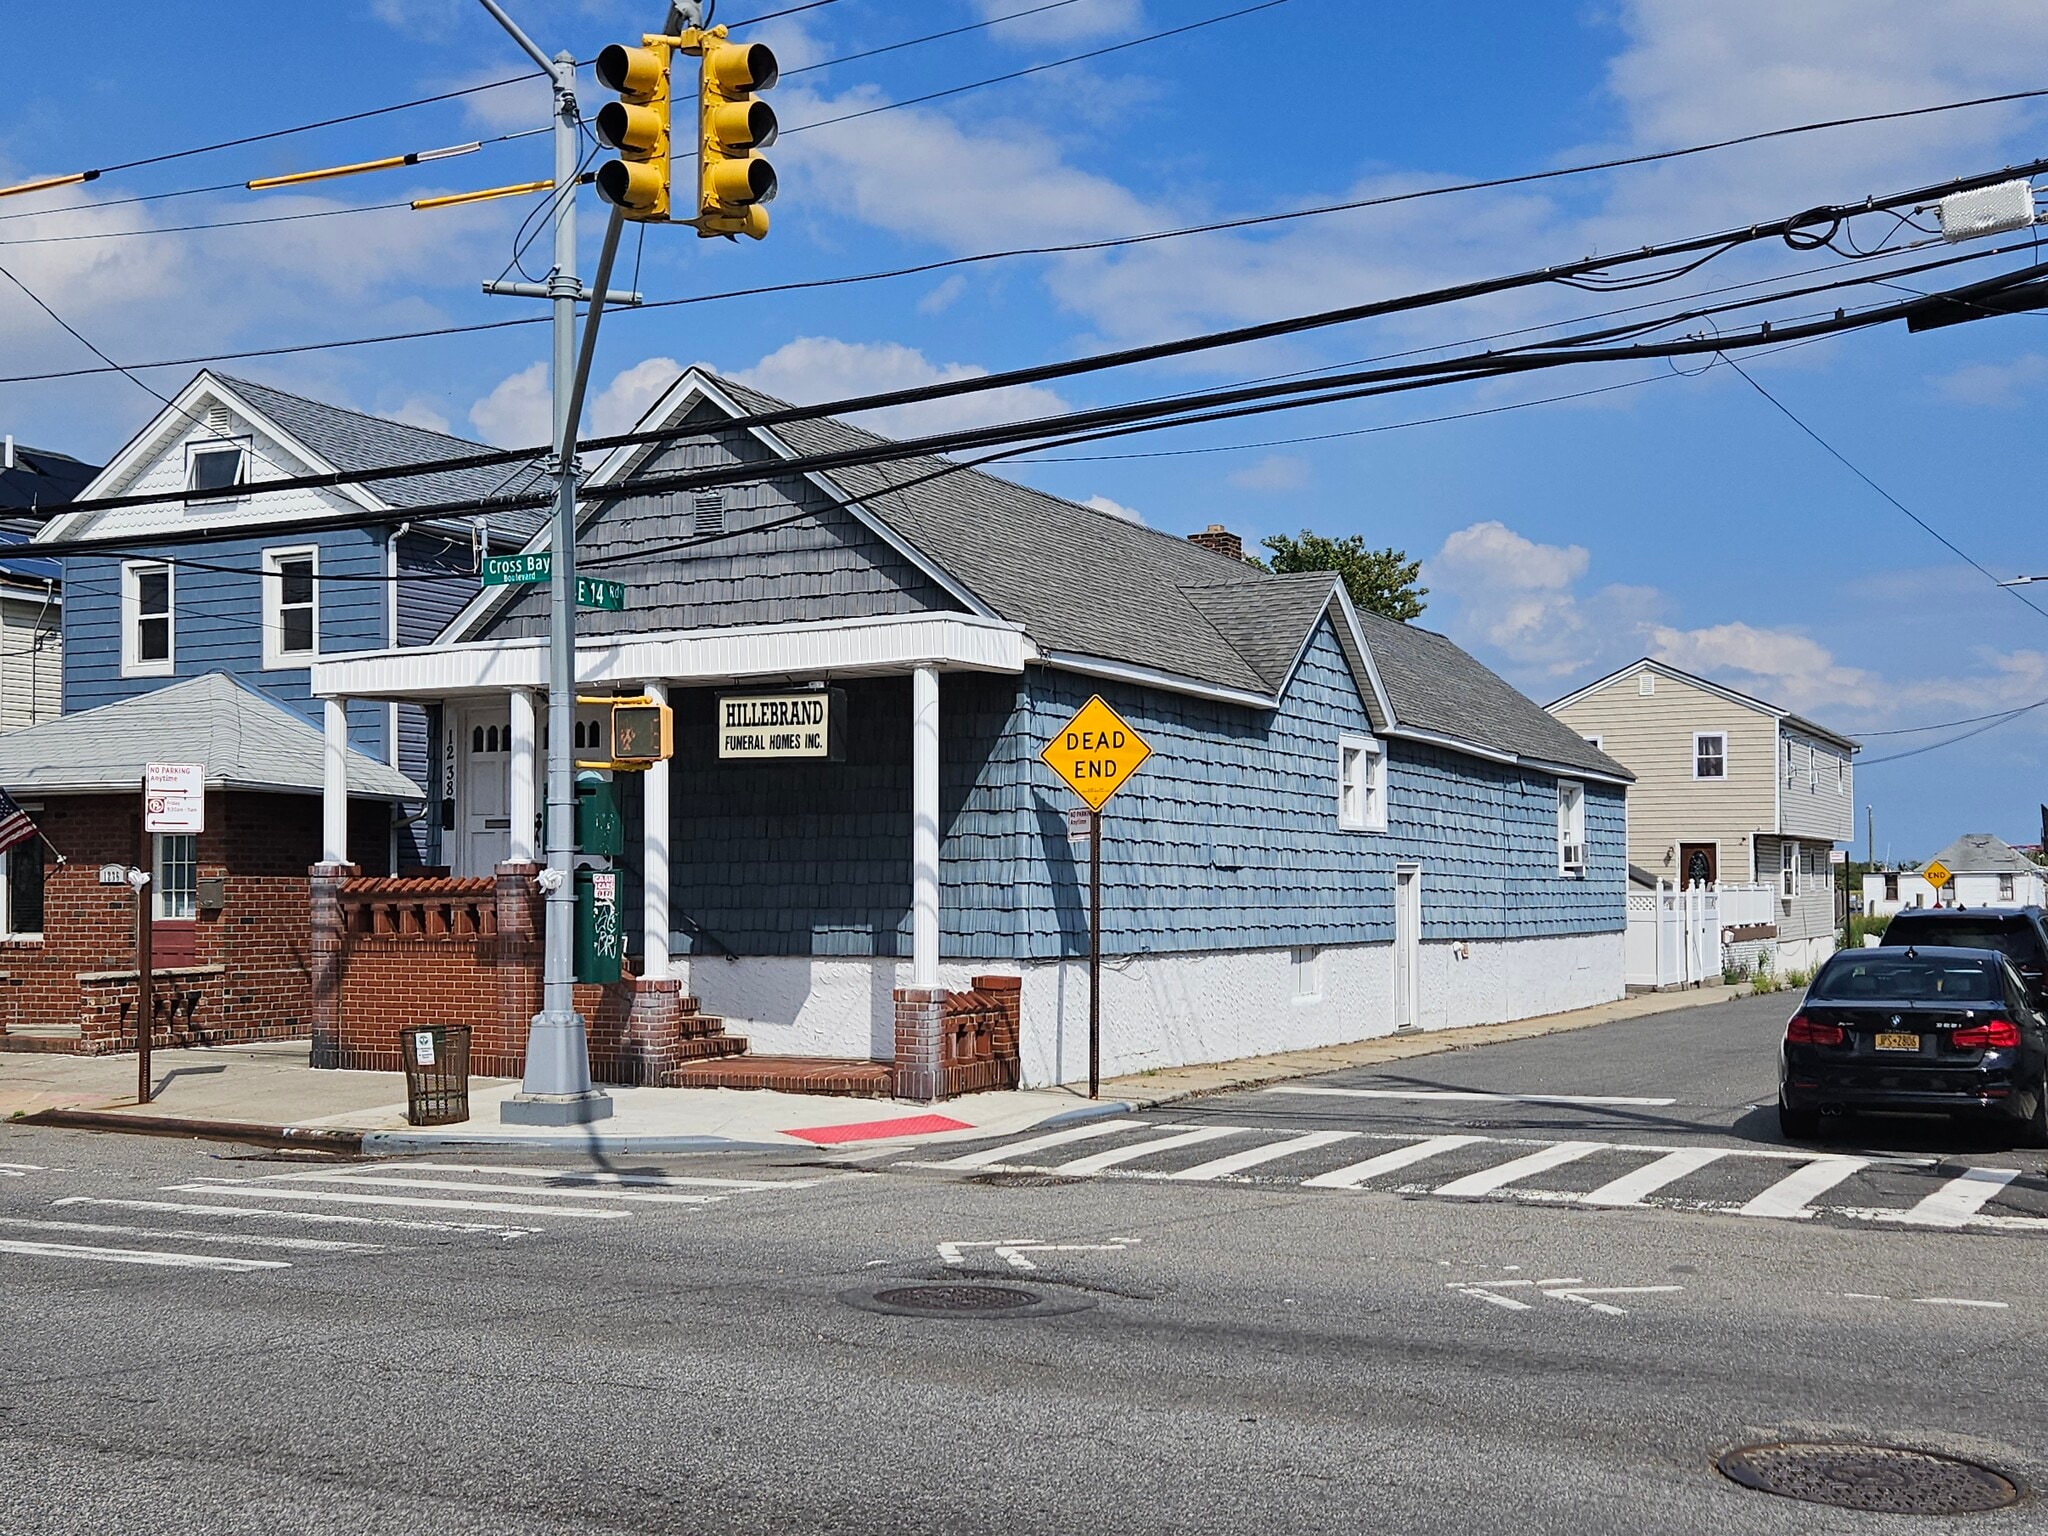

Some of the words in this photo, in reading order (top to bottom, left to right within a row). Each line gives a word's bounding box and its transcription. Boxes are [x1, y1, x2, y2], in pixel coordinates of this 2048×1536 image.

[489, 559, 522, 574] Cross
[527, 556, 550, 574] Bay
[503, 572, 536, 582] Boulevard
[578, 580, 585, 602] E
[591, 582, 604, 604] 14
[609, 585, 619, 599] Rd
[725, 700, 823, 728] HILLEBRAND
[725, 734, 765, 751] FUNERAL
[769, 733, 801, 750] HOMES
[805, 732, 822, 749] INC.
[1066, 730, 1125, 751] DEAD
[150, 766, 160, 774] NO
[1075, 759, 1117, 779] END
[1070, 818, 1087, 826] Anytime
[1927, 871, 1946, 879] END
